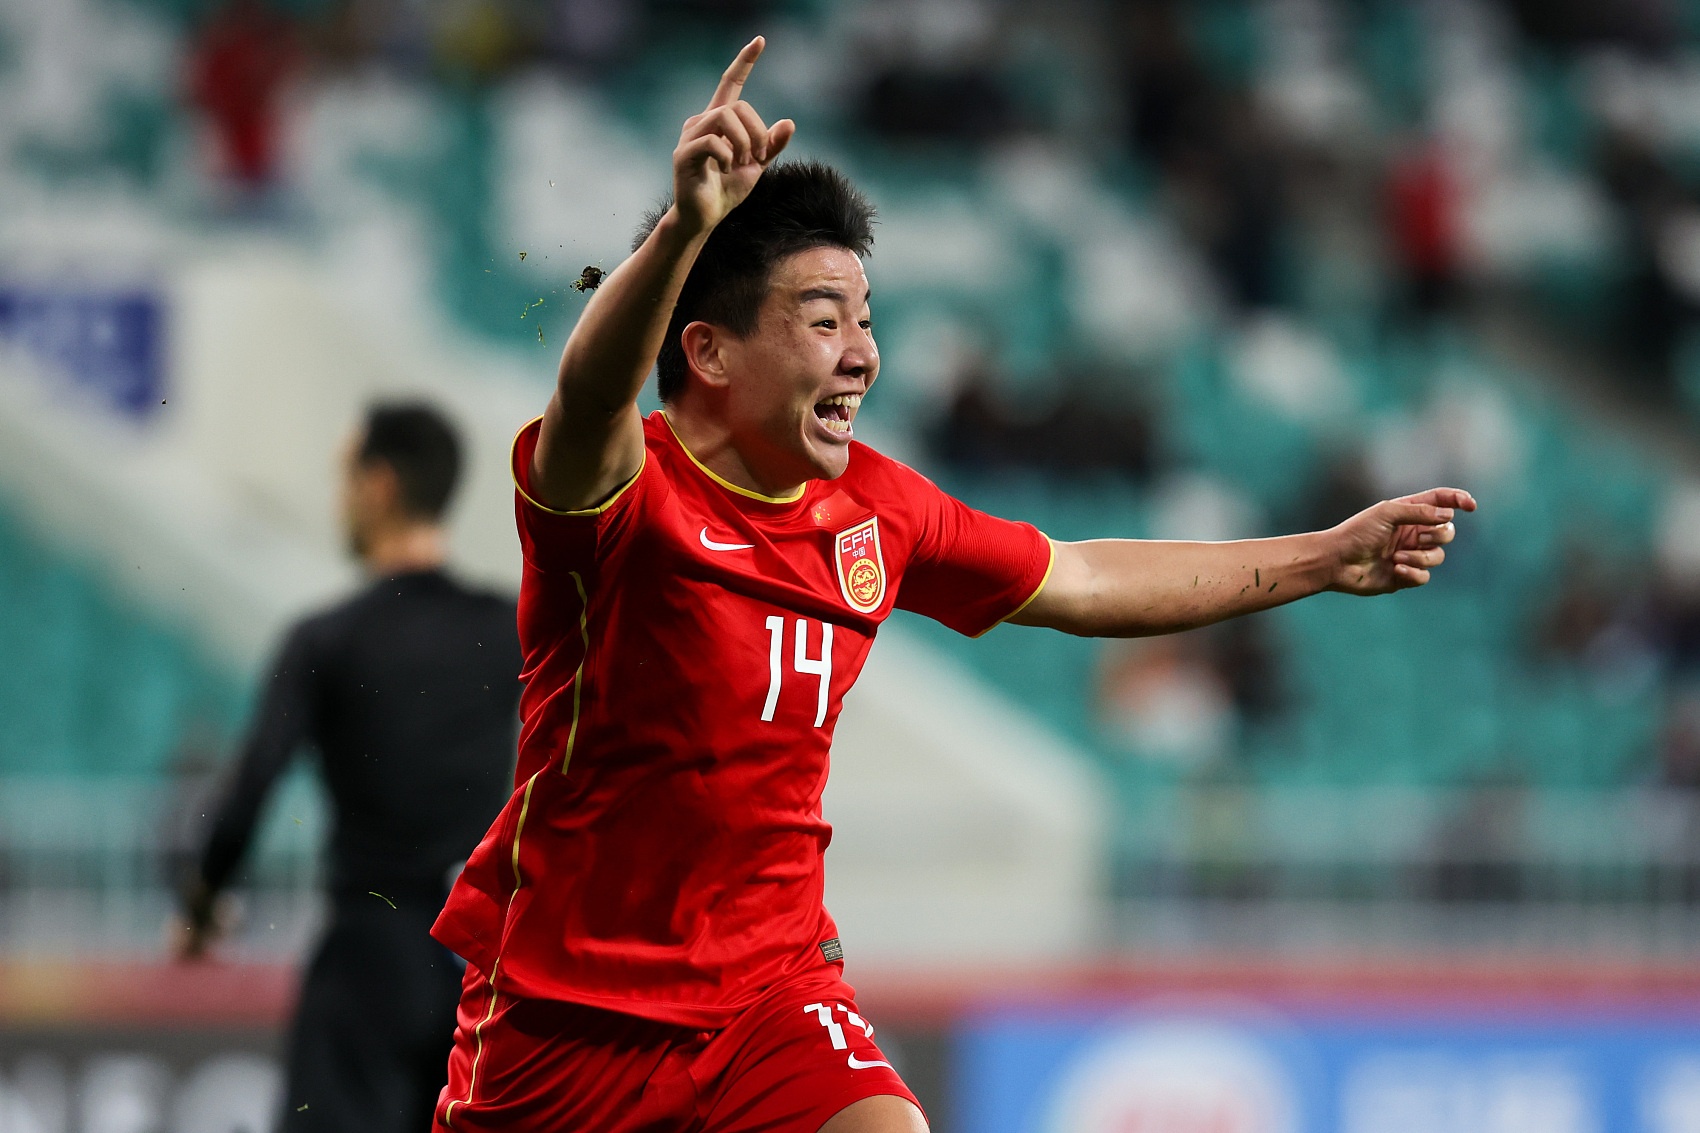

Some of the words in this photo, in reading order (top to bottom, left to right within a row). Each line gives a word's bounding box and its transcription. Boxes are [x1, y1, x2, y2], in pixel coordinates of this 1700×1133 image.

[841, 527, 873, 553] CFA
[852, 546, 866, 559] 中国
[761, 616, 833, 727] 14
